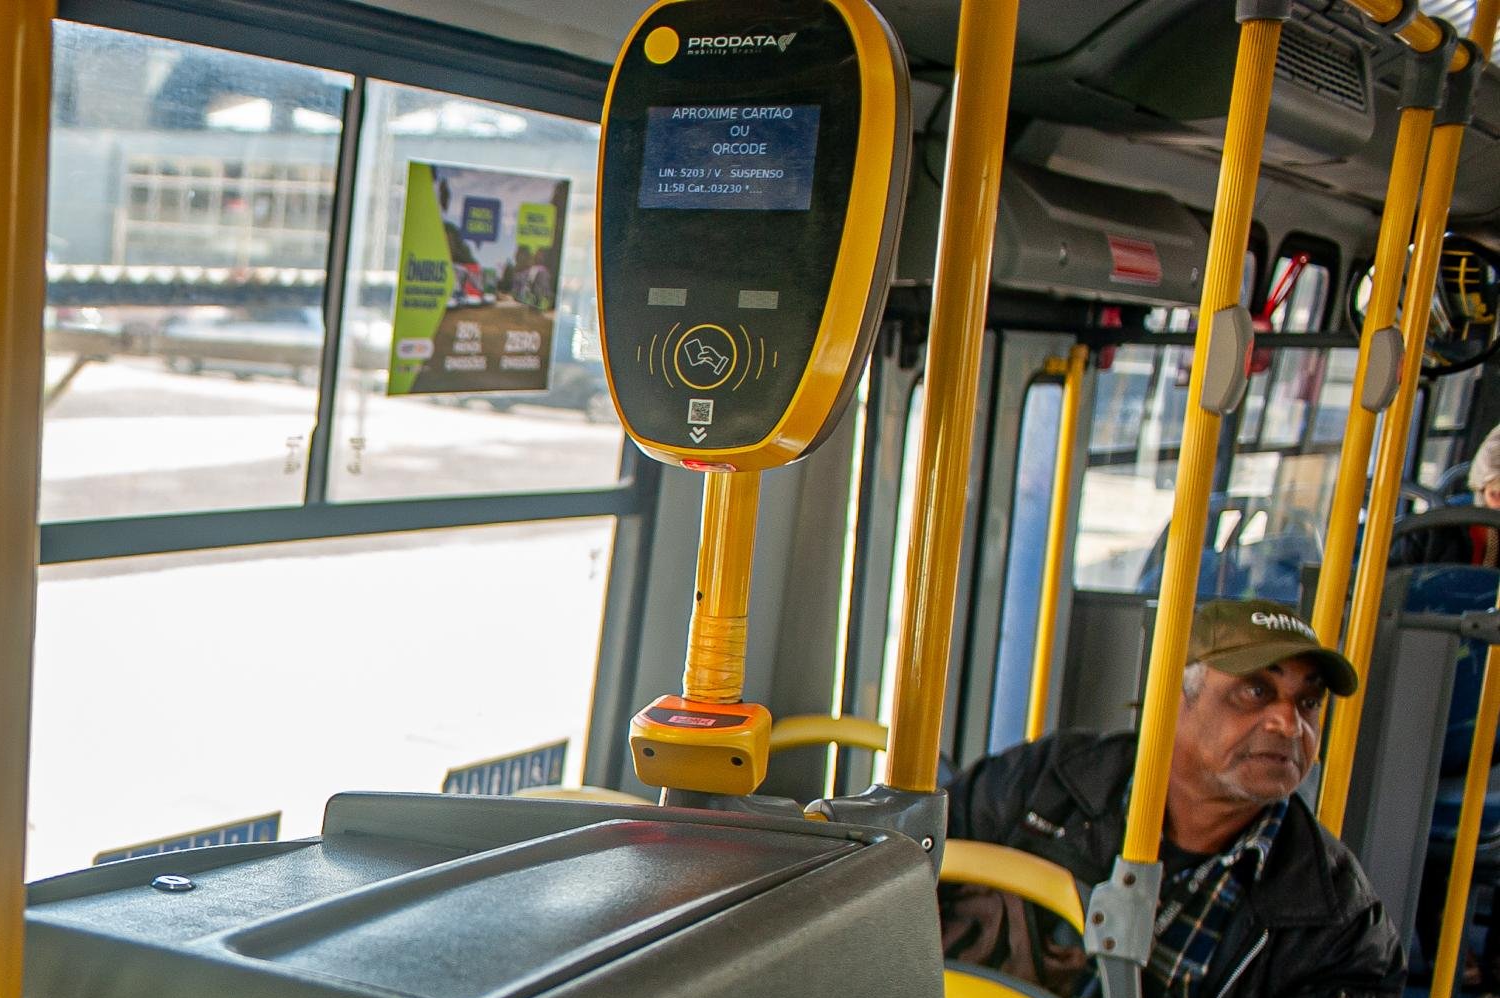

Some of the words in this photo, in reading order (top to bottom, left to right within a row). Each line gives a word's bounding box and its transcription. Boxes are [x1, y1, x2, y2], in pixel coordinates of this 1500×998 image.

[688, 35, 777, 48] PRODATA
[672, 107, 738, 119] APROXIME
[742, 107, 793, 119] CARTAO
[730, 125, 750, 137] OU
[712, 143, 767, 155] QRCODE
[659, 168, 678, 177] LIN:
[681, 168, 705, 177] 5203
[730, 168, 784, 179] SUSPENSO
[658, 183, 685, 193] 11:58
